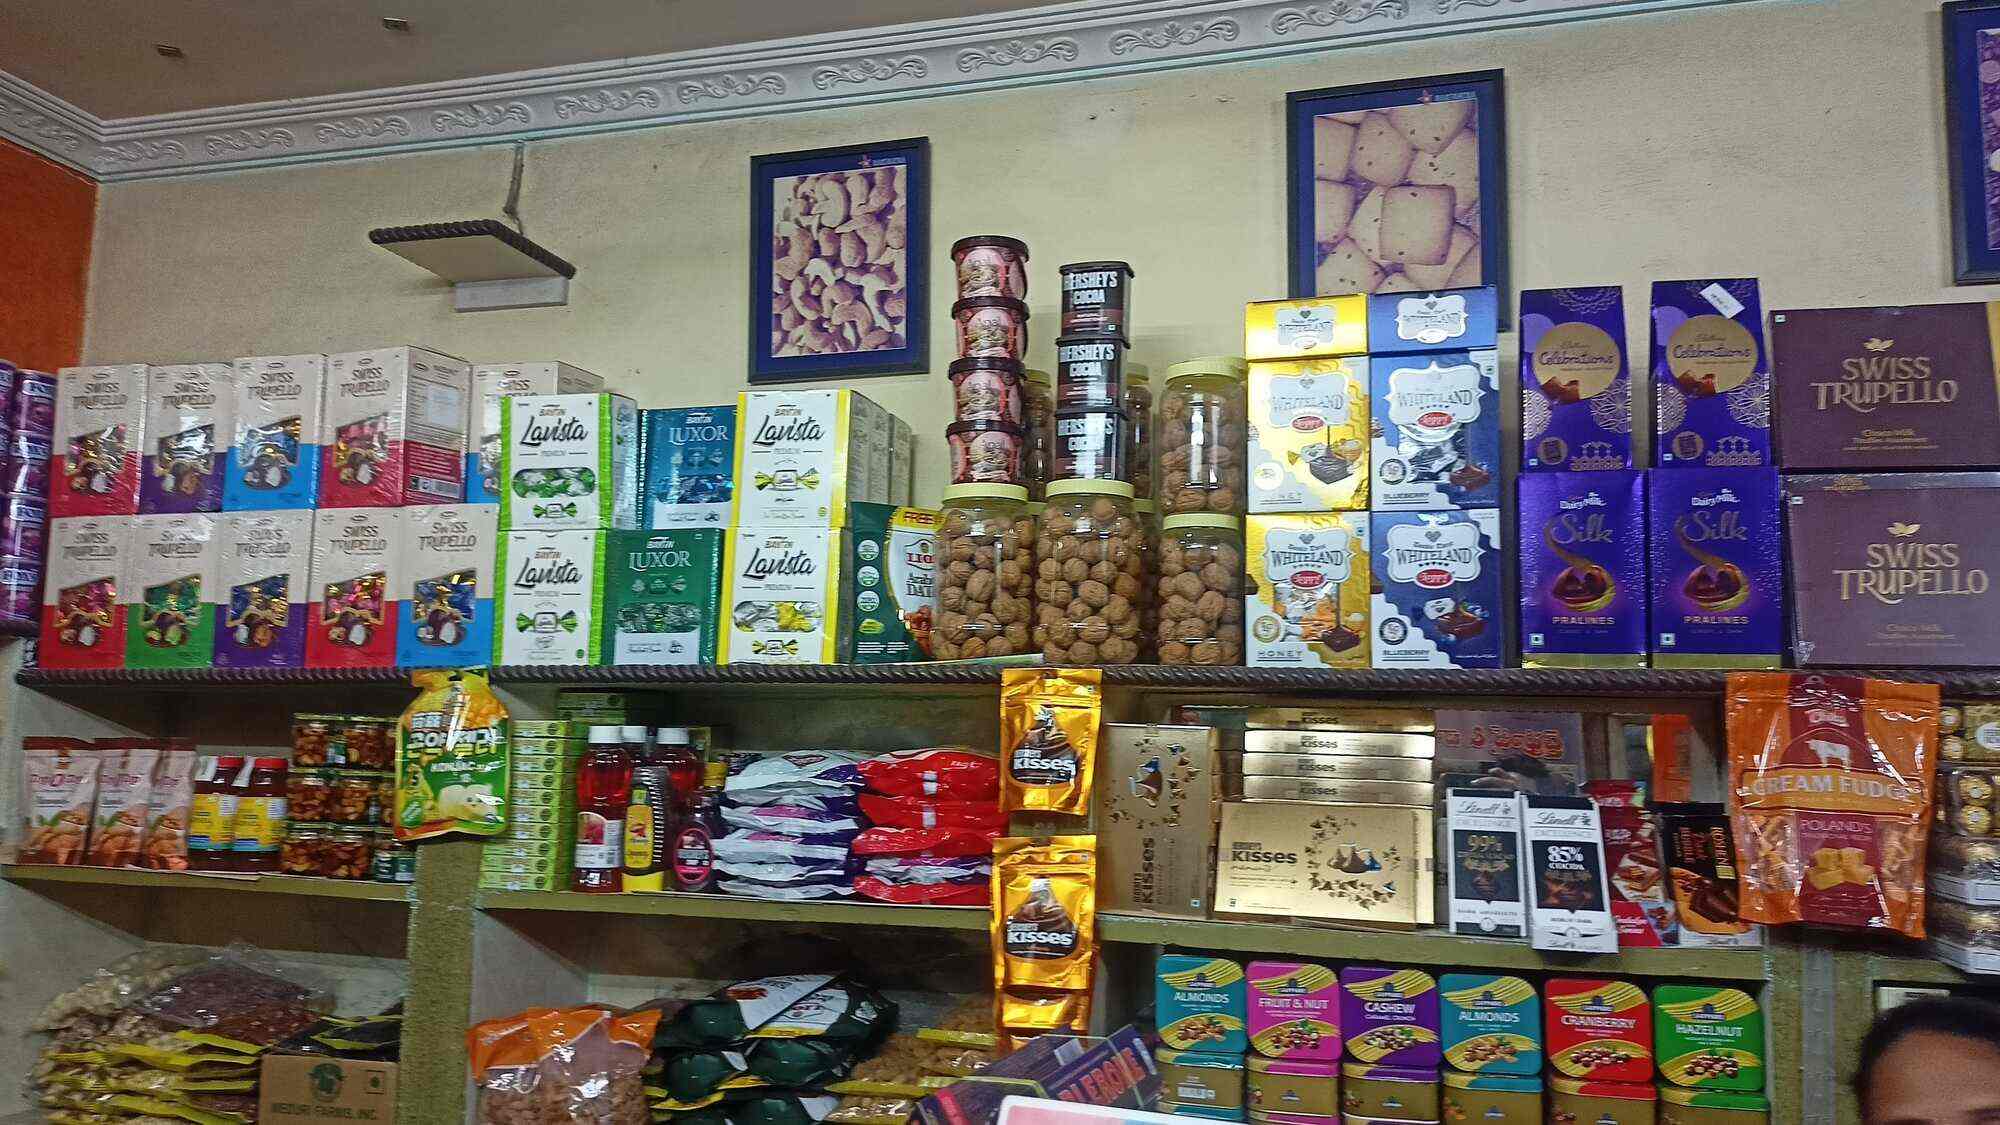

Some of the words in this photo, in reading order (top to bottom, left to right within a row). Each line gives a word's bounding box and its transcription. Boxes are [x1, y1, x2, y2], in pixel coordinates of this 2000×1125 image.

[1062, 271, 1118, 290] HERSHEY'S
[1072, 289, 1105, 304] COCOA
[1059, 344, 1115, 362] HERSHEY'S
[1539, 351, 1614, 365] Celebrations
[1673, 344, 1750, 359] Celebrations
[1069, 361, 1102, 377] COCOA
[1841, 356, 1931, 381] SWISS
[1808, 380, 1960, 413] TRUPELLO
[519, 415, 588, 446] Lavista
[668, 425, 729, 446] LUXOR
[752, 414, 825, 448] Lavista
[432, 521, 469, 535] SWISS
[1551, 513, 1614, 544] Silk
[1682, 510, 1747, 541] Silk
[628, 551, 692, 572] LUXOR
[742, 547, 817, 580] Lavista
[1271, 550, 1344, 568] WHITELAND
[1396, 548, 1473, 567] WHITELAND
[1866, 543, 1960, 568] SWISS
[514, 557, 583, 589] Lavista
[1832, 569, 1989, 605] TRUPELLO
[1552, 616, 1616, 626] PRALINES
[1683, 616, 1750, 625] PRALINES
[1257, 650, 1302, 658] HONEY
[1753, 774, 1833, 797] CREAM
[1457, 801, 1501, 815] Lindt
[1534, 811, 1578, 825] Lindt
[1548, 845, 1584, 863] 85%
[1174, 992, 1230, 1005] ALMONDS
[1258, 998, 1291, 1009] FRUIT
[1293, 999, 1302, 1009] &
[1303, 999, 1329, 1010] NUT
[1364, 1002, 1416, 1015] CASHEW
[1458, 1012, 1520, 1024] ALMONDS
[1560, 1015, 1637, 1030] CRANBERRY
[1675, 1023, 1744, 1038] HAZELNUT
